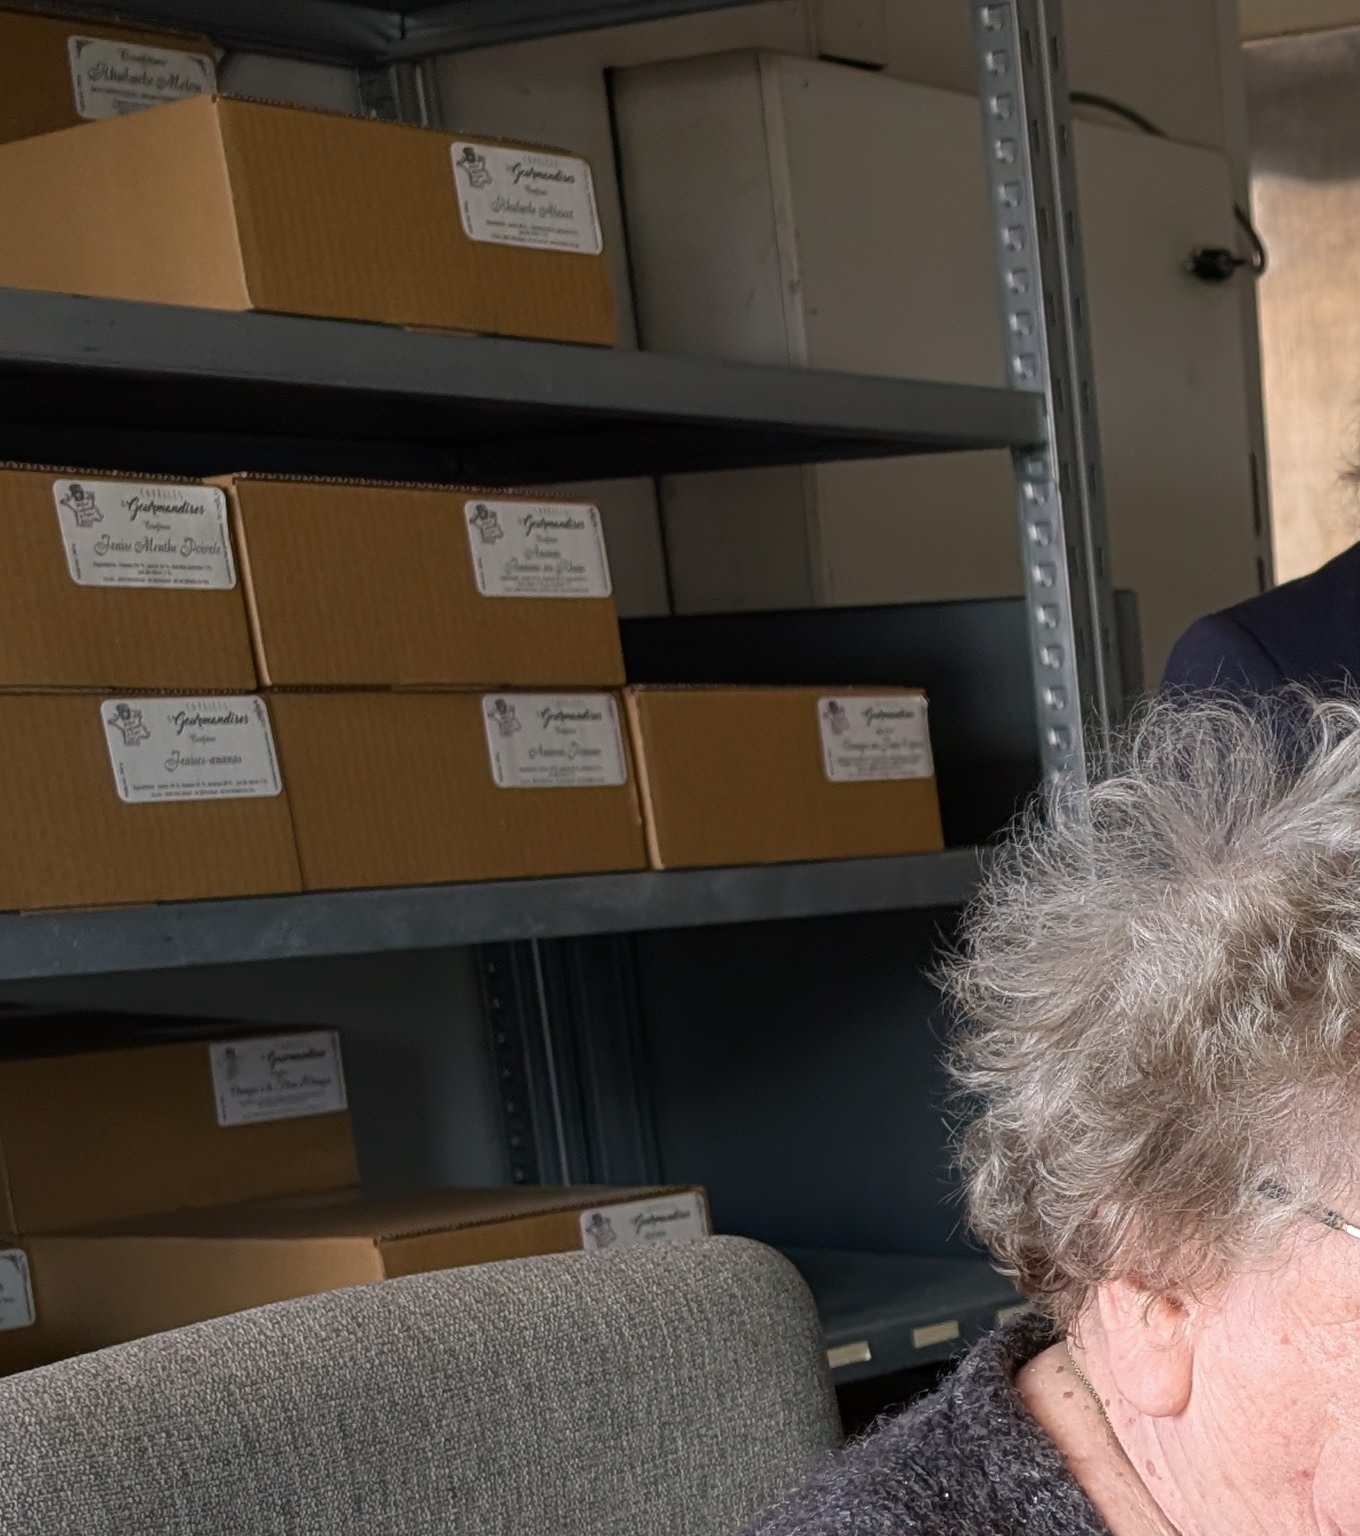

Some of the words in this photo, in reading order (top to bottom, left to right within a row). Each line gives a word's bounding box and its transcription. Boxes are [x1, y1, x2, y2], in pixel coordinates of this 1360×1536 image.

[512, 162, 576, 184] Gourmandises
[127, 496, 205, 521] Gourmandises
[133, 535, 178, 554] Menthe
[173, 710, 249, 736] Gourmandises
